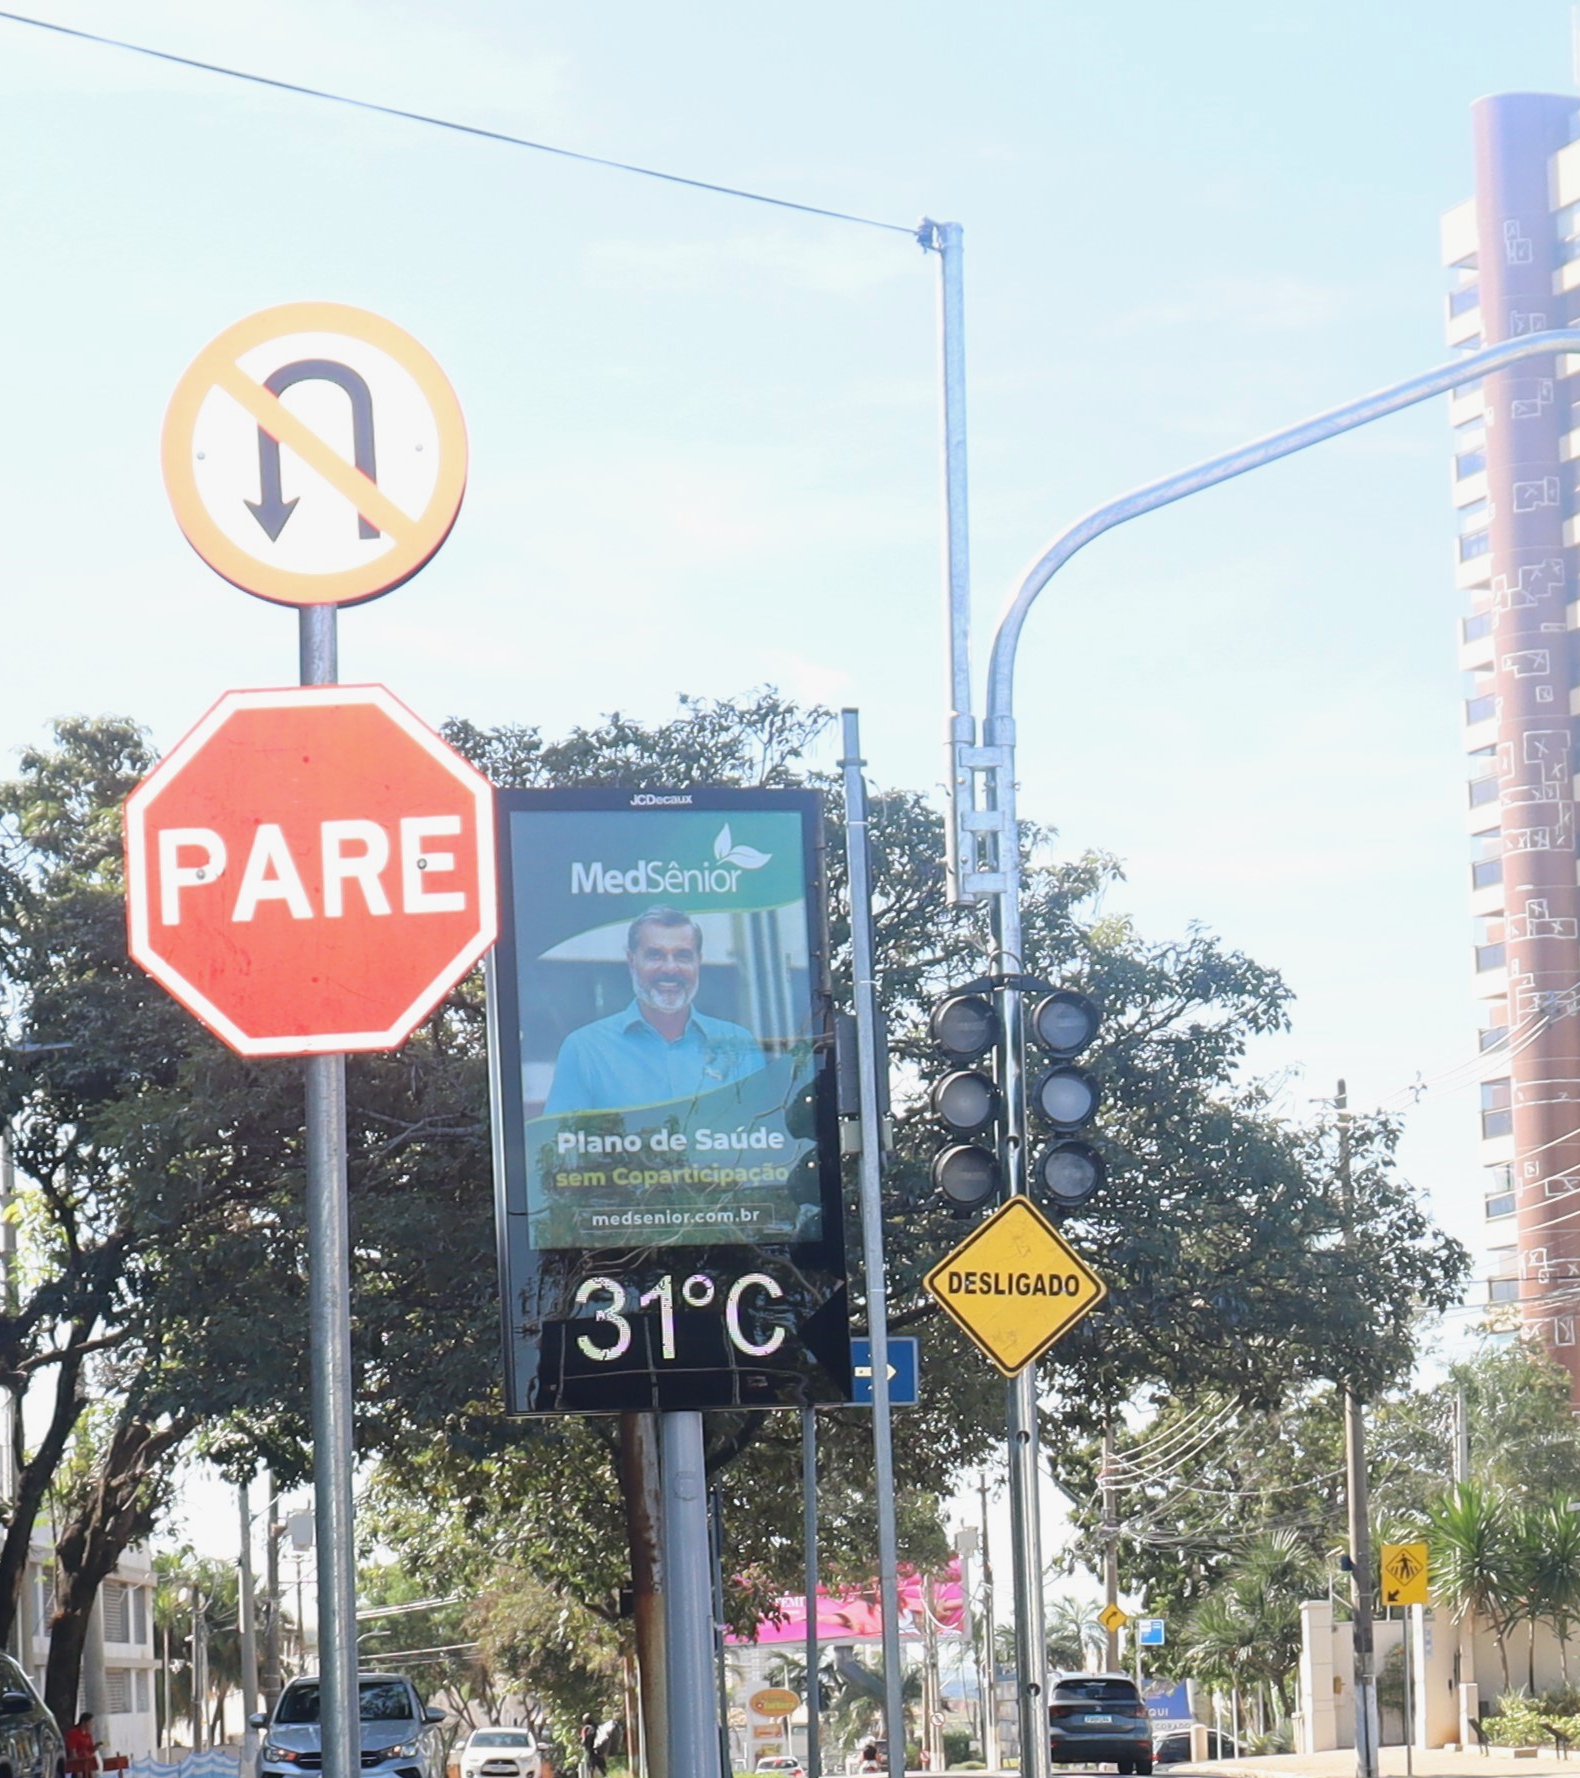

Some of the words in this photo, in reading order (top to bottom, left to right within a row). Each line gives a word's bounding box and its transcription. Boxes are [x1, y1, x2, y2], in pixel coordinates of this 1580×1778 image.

[630, 794, 693, 806] JCDecaux
[158, 814, 467, 926] PARE
[571, 860, 742, 894] MedSênior
[556, 1131, 642, 1154] Plano
[650, 1129, 687, 1151] de
[695, 1126, 785, 1150] Saúde
[556, 1171, 606, 1188] sem
[612, 1161, 790, 1188] Coparticipação
[592, 1208, 761, 1226] medsenior.com.br
[948, 1271, 1080, 1297] DESLIGADO
